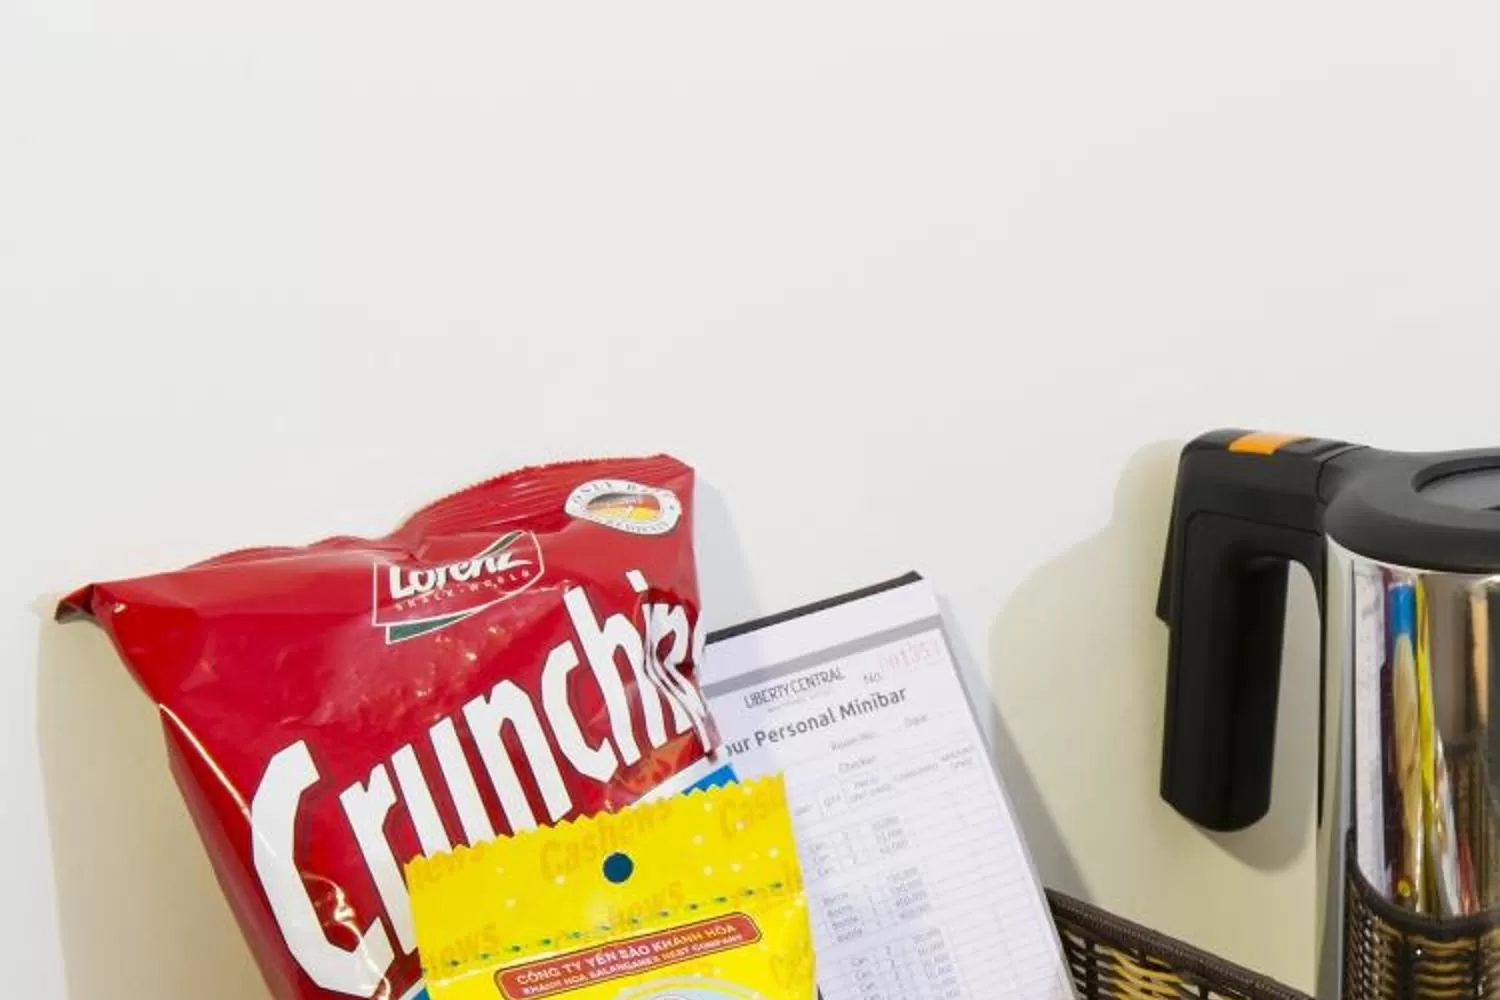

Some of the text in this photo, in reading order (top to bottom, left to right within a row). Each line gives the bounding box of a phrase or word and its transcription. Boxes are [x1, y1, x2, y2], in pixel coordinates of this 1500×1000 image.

[389, 548, 533, 600] Lorenz
[725, 737, 750, 757] ur
[754, 706, 836, 744] Personal
[839, 686, 907, 721] Minibar
